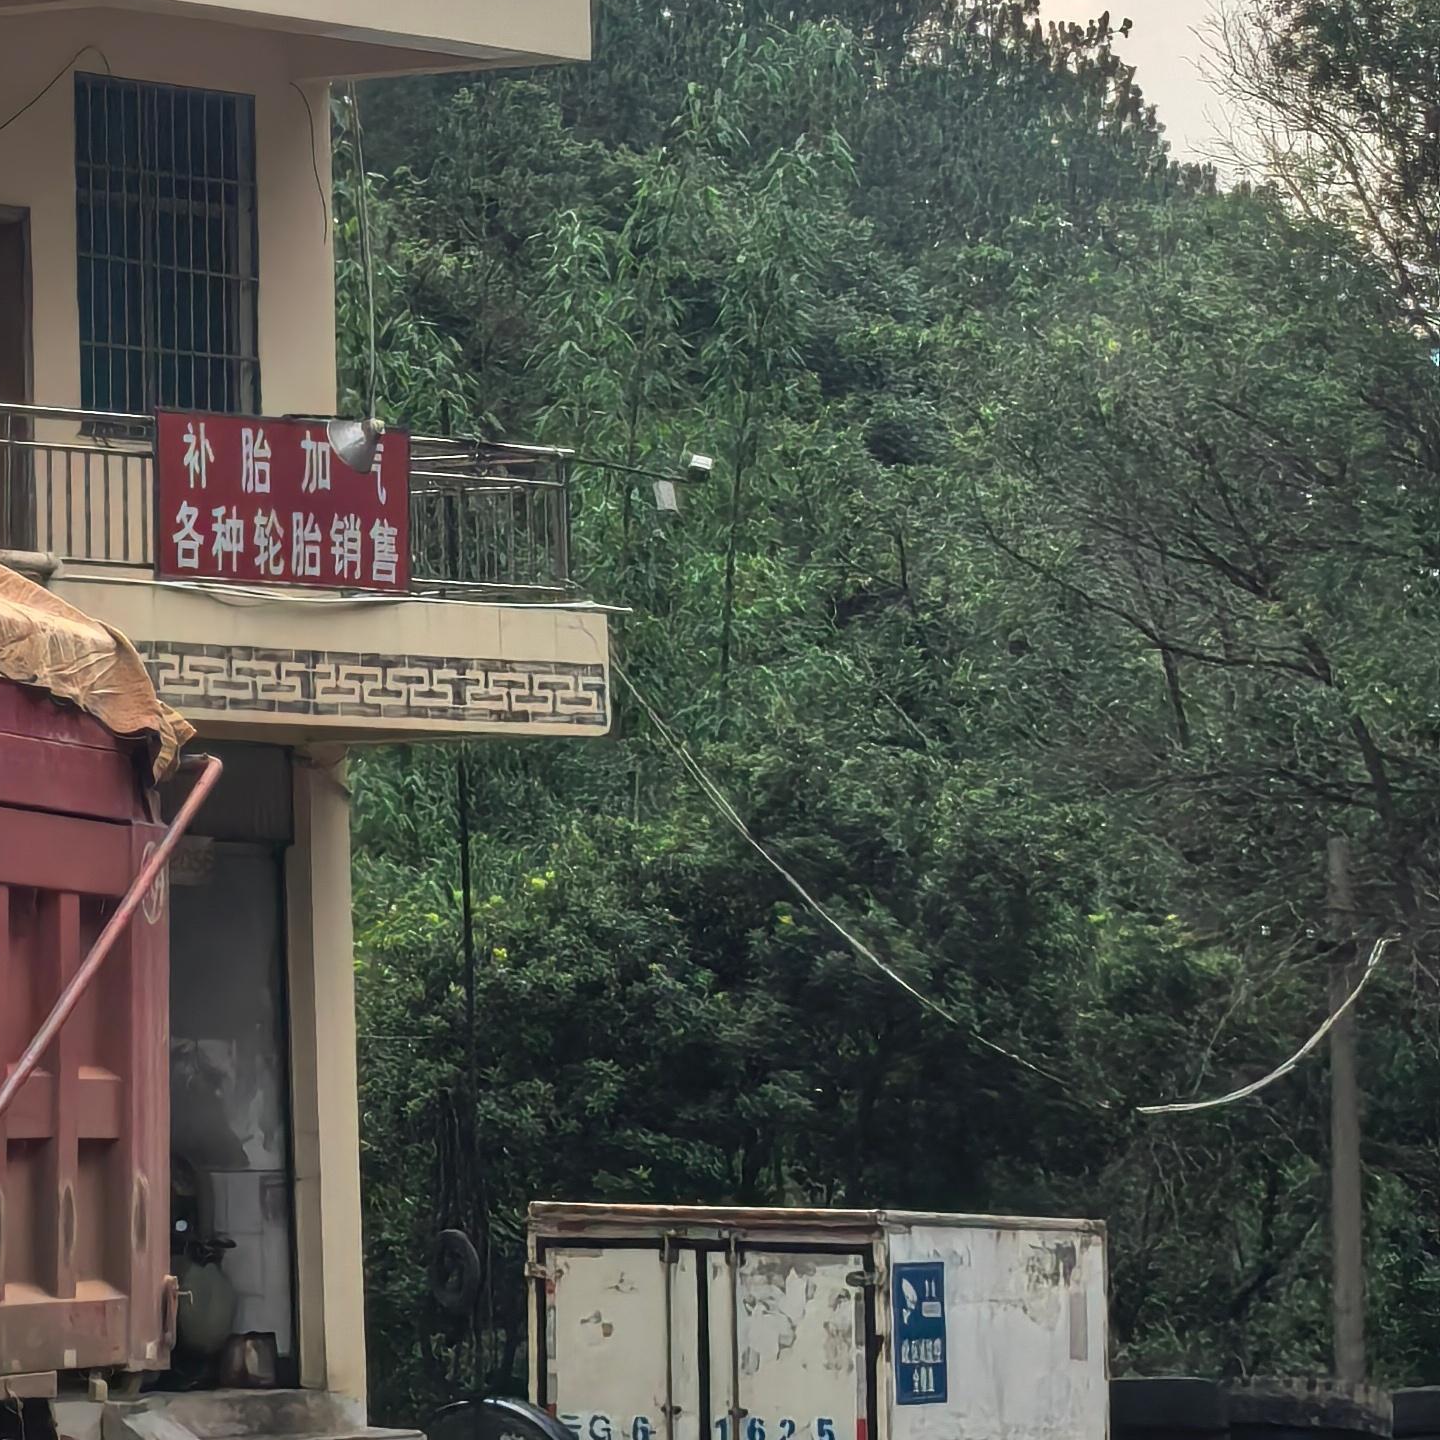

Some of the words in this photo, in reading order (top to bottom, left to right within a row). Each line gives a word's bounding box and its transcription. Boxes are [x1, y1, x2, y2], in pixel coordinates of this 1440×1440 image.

[171, 499, 399, 586] 各种轮胎销售
